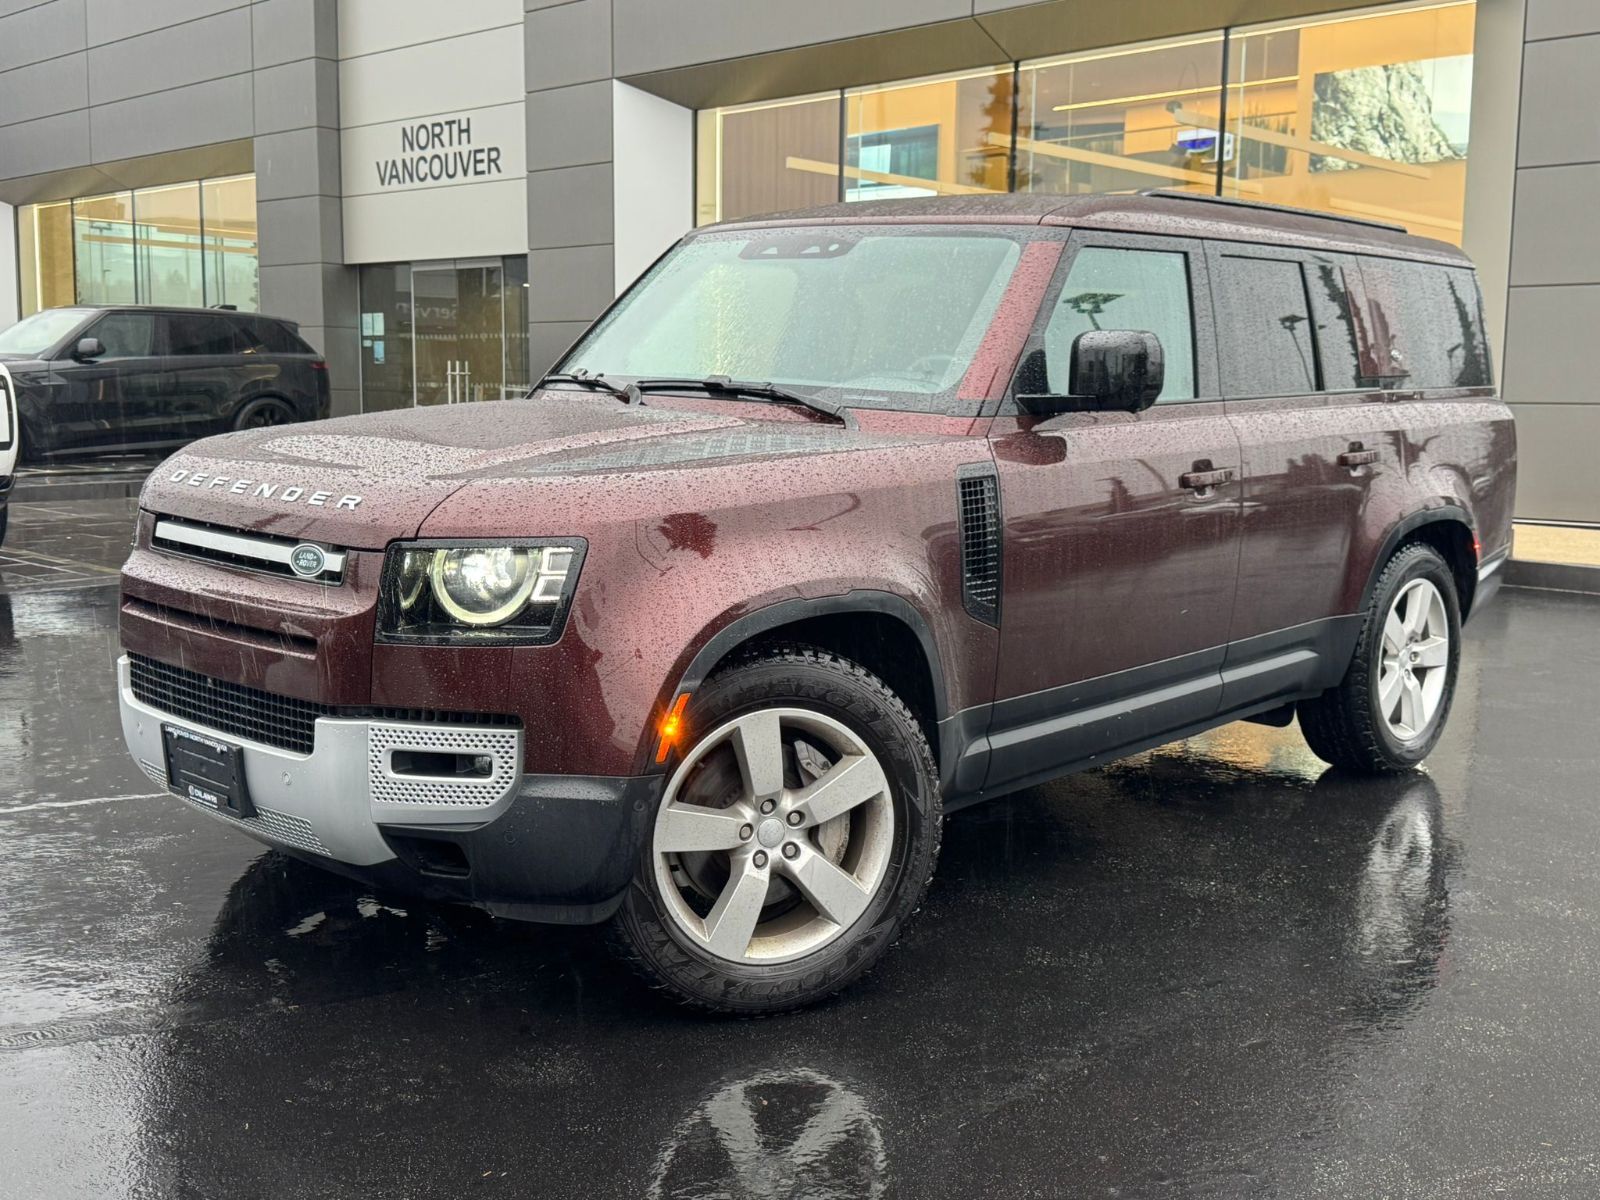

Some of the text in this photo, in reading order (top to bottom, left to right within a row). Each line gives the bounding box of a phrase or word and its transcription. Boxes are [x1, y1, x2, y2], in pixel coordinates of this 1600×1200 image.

[402, 117, 471, 153] NORTH
[376, 147, 502, 186] VANCOUVER
[169, 469, 363, 510] DEFENDER
